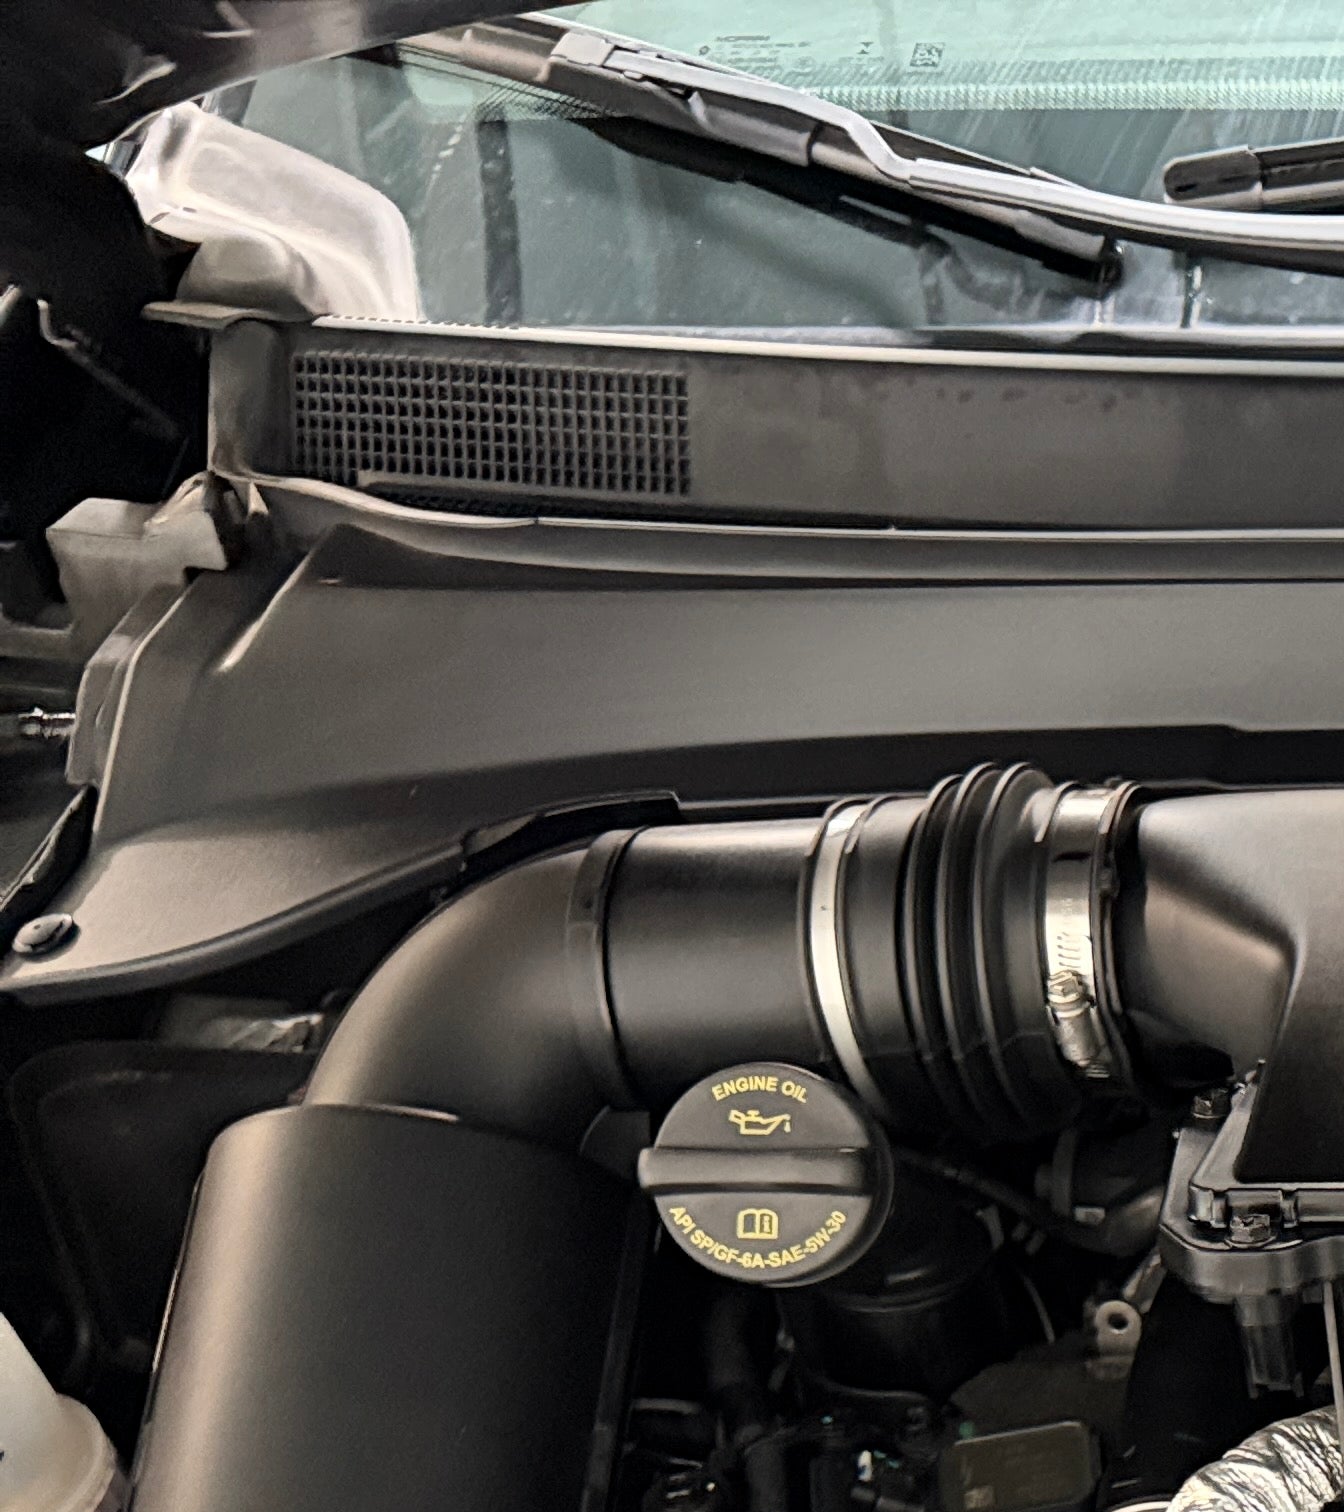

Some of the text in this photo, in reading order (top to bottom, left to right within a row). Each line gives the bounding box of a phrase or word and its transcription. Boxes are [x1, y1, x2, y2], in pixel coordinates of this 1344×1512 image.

[711, 1076, 808, 1103] ENGINE OIL
[669, 1205, 847, 1268] API SP/GF-6A-SAE-5W-30
